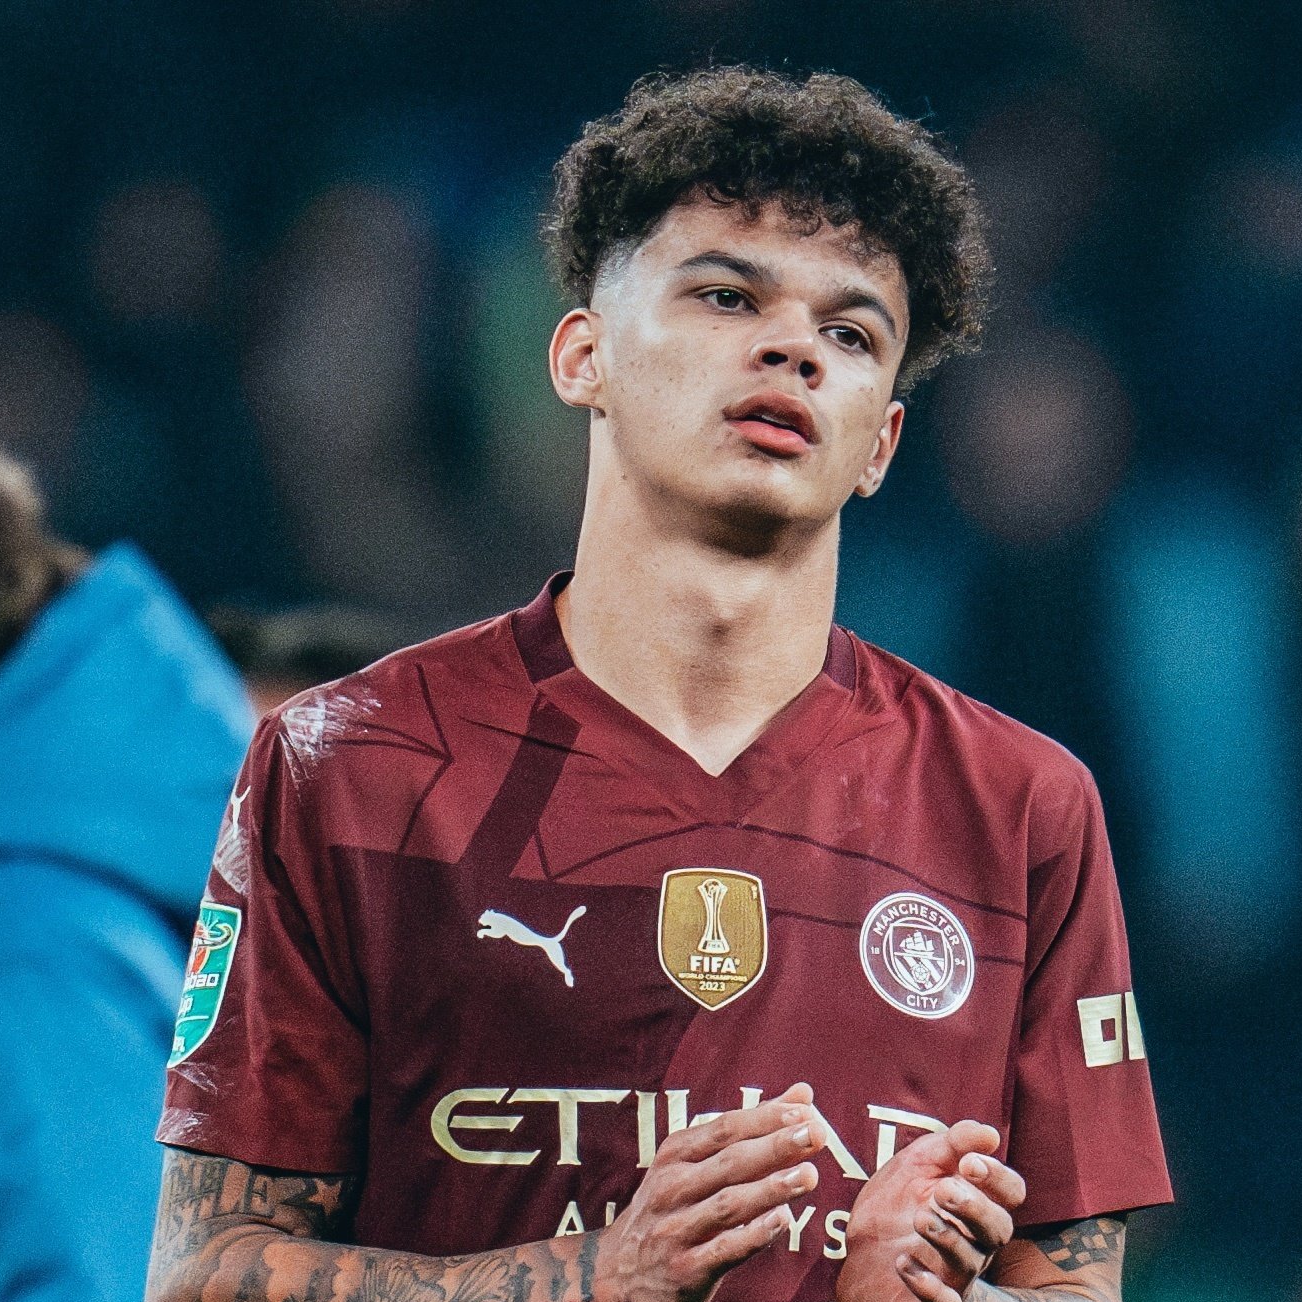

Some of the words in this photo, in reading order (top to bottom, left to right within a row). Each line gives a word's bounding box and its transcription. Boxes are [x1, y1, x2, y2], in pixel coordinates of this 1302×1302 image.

[872, 903, 960, 947] MANCHESTER
[690, 955, 737, 974] FIFA
[699, 981, 726, 992] 2023
[906, 994, 938, 1010] CITY
